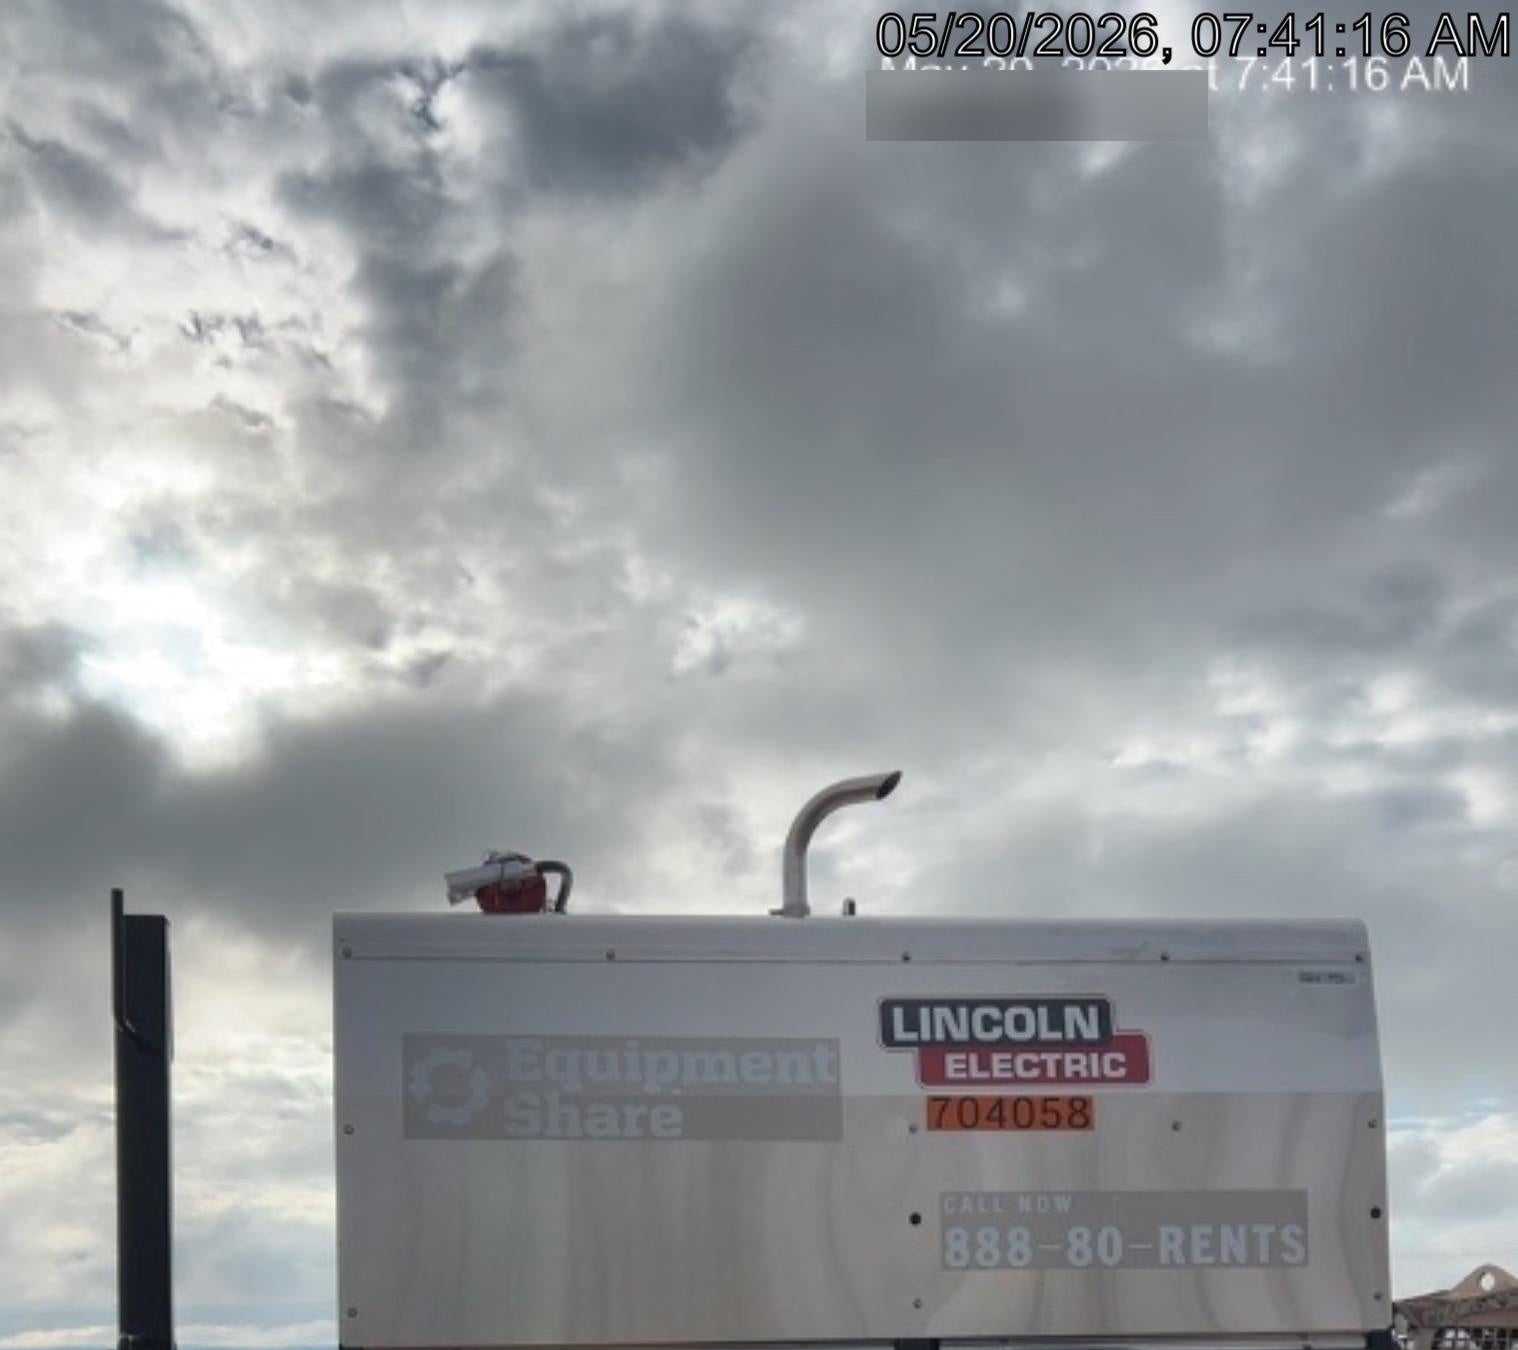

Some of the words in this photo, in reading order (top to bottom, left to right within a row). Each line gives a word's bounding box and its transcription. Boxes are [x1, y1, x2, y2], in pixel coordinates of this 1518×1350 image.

[893, 1006, 1100, 1041] LINCOLN
[506, 1039, 837, 1095] Equipment
[944, 1052, 1127, 1079] ELECTRIC
[506, 1090, 683, 1138] Share
[930, 1097, 1091, 1129] 704058
[943, 1196, 1003, 1214] CALL
[1019, 1196, 1073, 1214] NOW
[944, 1224, 1306, 1267] 888-80-RENTS
